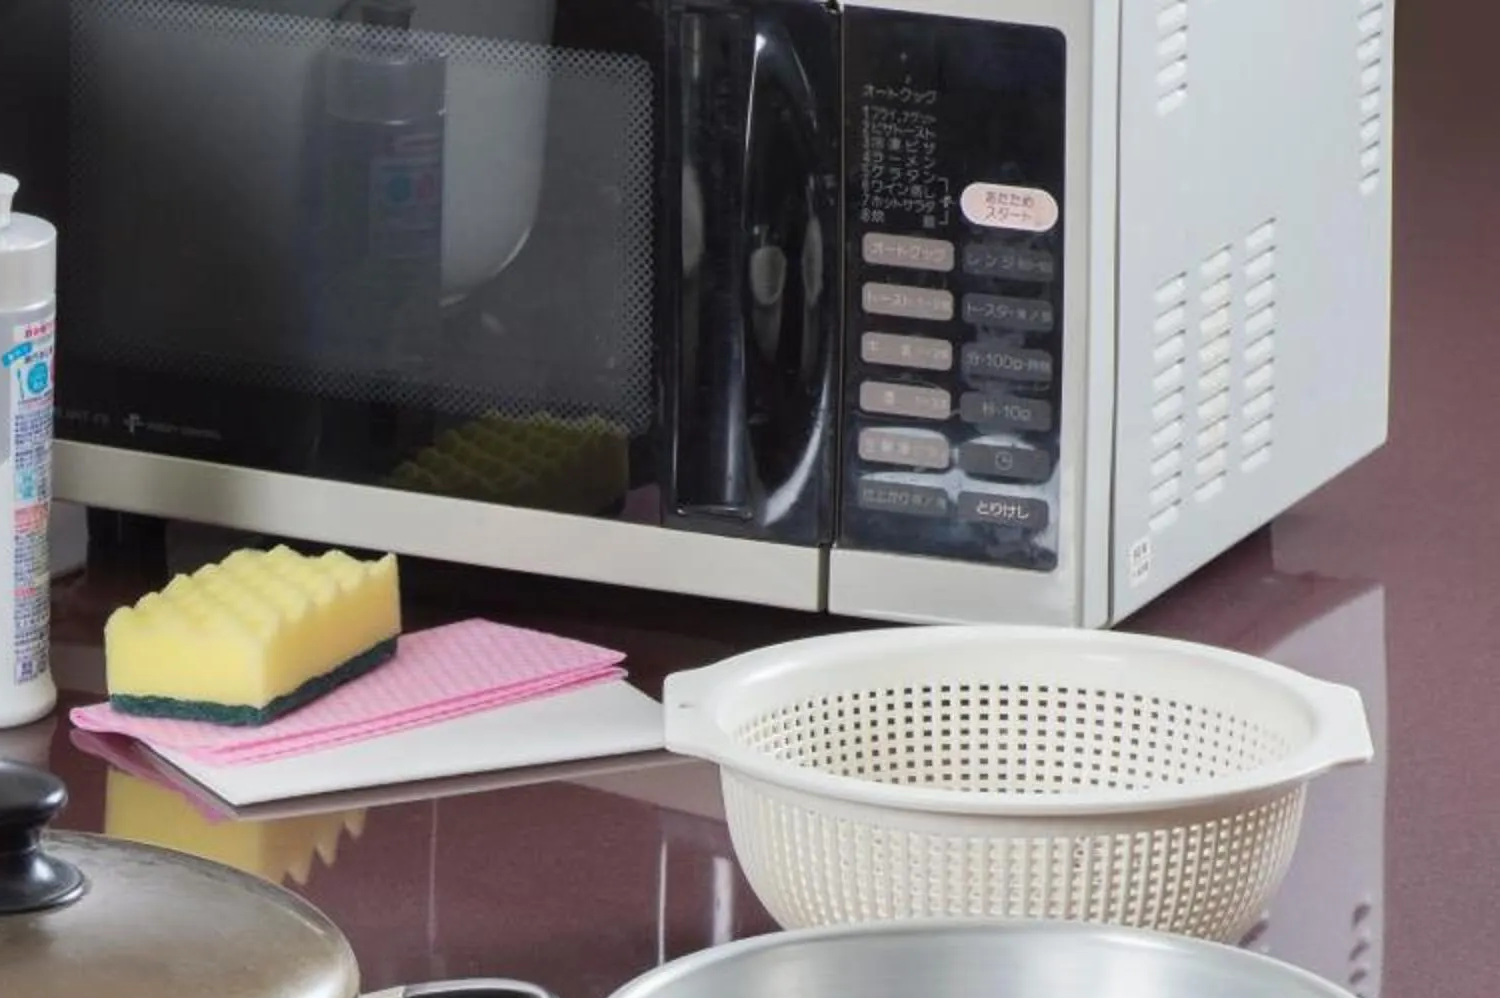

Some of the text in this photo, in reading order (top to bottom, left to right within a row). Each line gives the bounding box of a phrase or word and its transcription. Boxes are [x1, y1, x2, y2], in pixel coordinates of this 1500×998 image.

[985, 191, 1035, 208] あたため
[986, 206, 1033, 221] スタート
[975, 499, 1030, 520] とりけし
